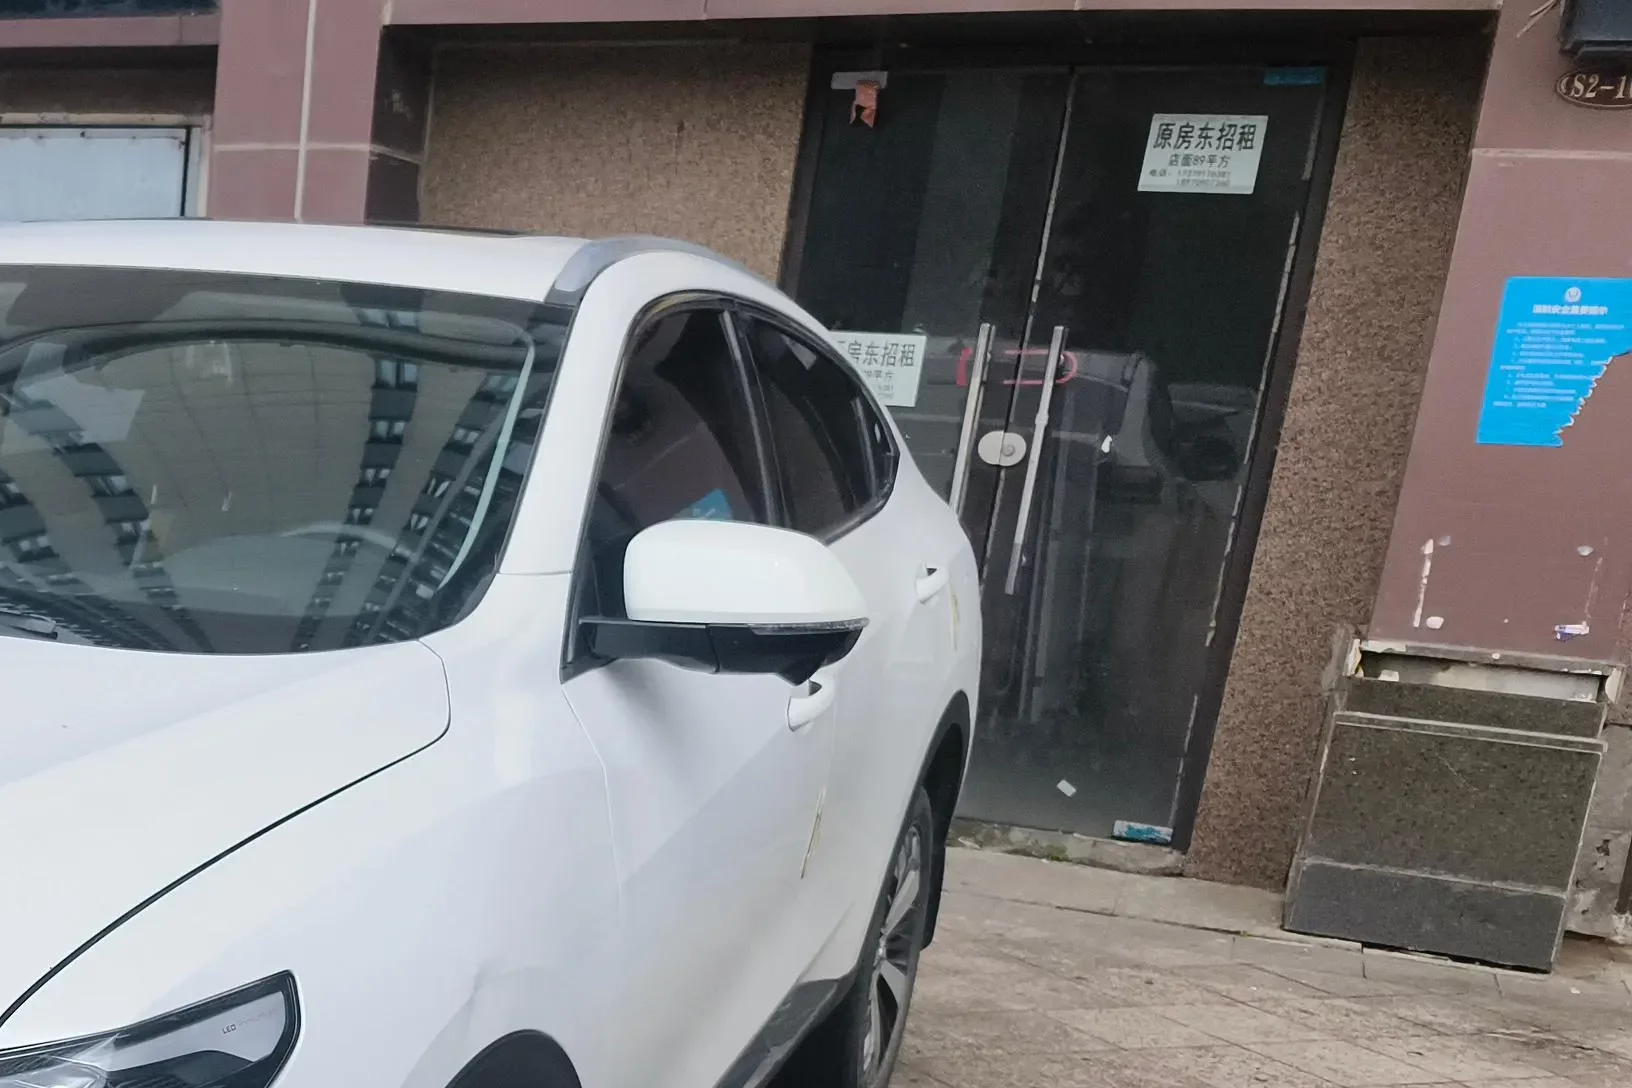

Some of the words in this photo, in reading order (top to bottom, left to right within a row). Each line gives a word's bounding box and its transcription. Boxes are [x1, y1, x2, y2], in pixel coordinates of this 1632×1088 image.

[1153, 122, 1257, 151] 原房东招租
[838, 340, 916, 367] 房东招租
